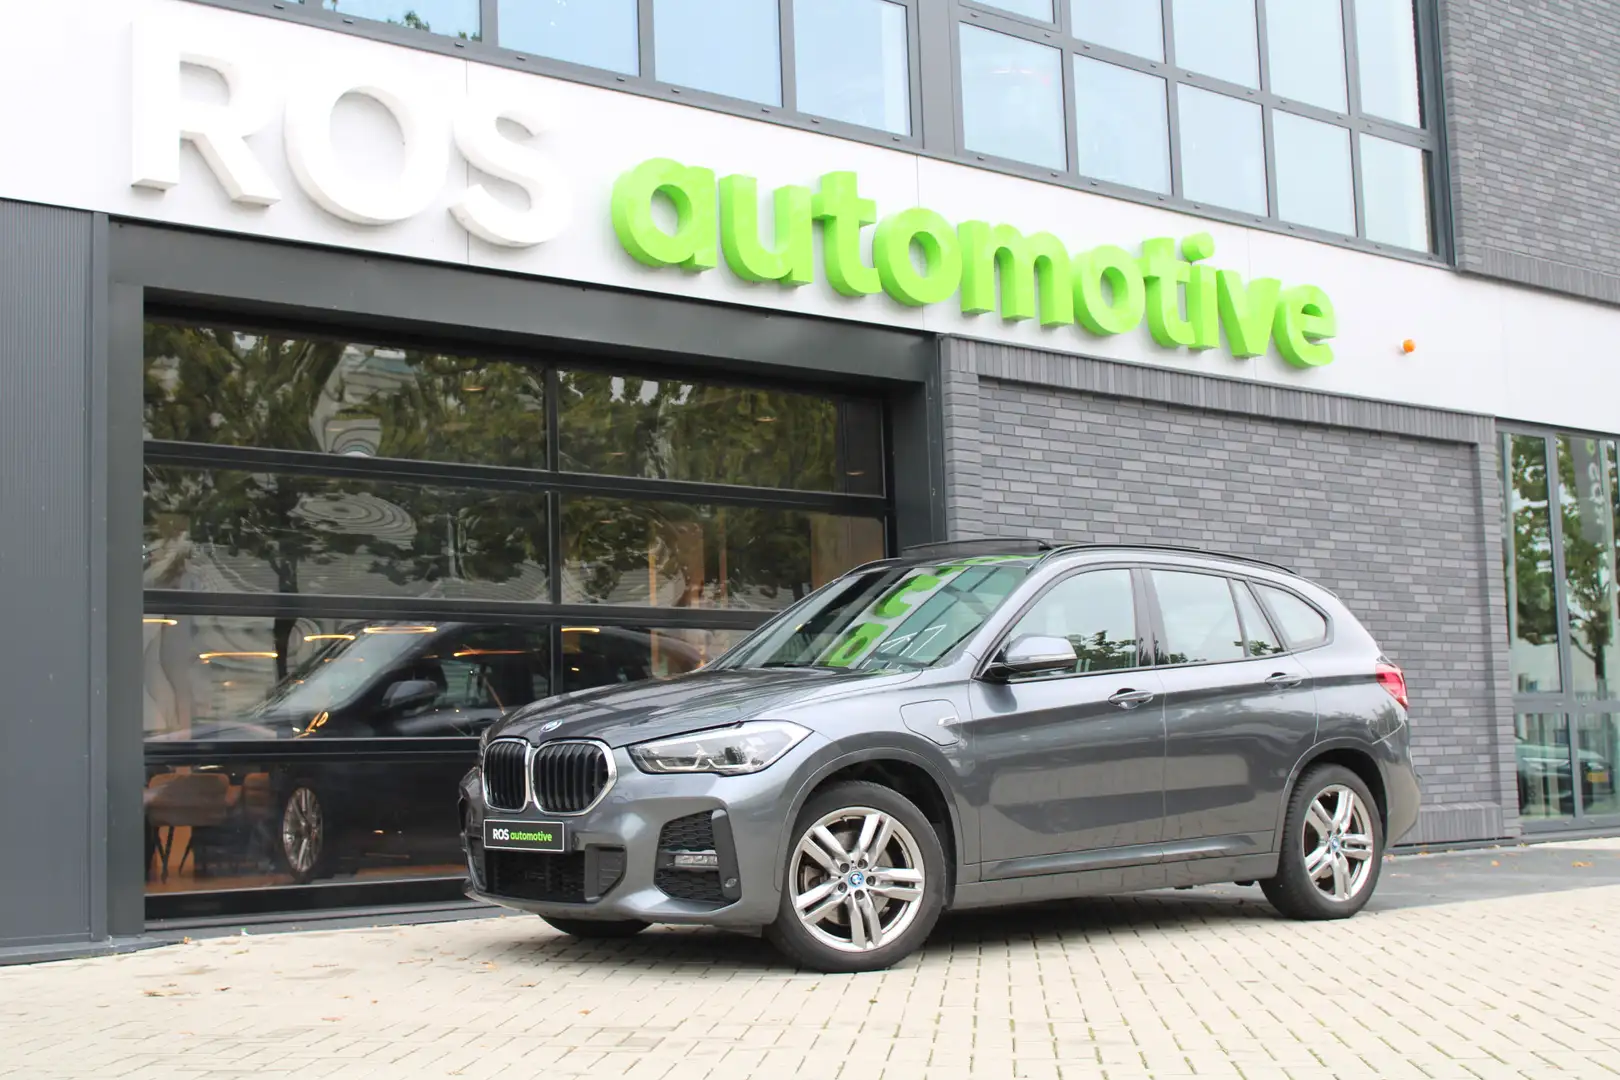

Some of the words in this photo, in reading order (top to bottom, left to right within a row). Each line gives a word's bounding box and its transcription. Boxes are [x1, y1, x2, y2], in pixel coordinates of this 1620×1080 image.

[131, 20, 573, 247] ROS
[611, 159, 1336, 368] automotive
[492, 828, 509, 841] ROS
[510, 830, 553, 842] automotive
